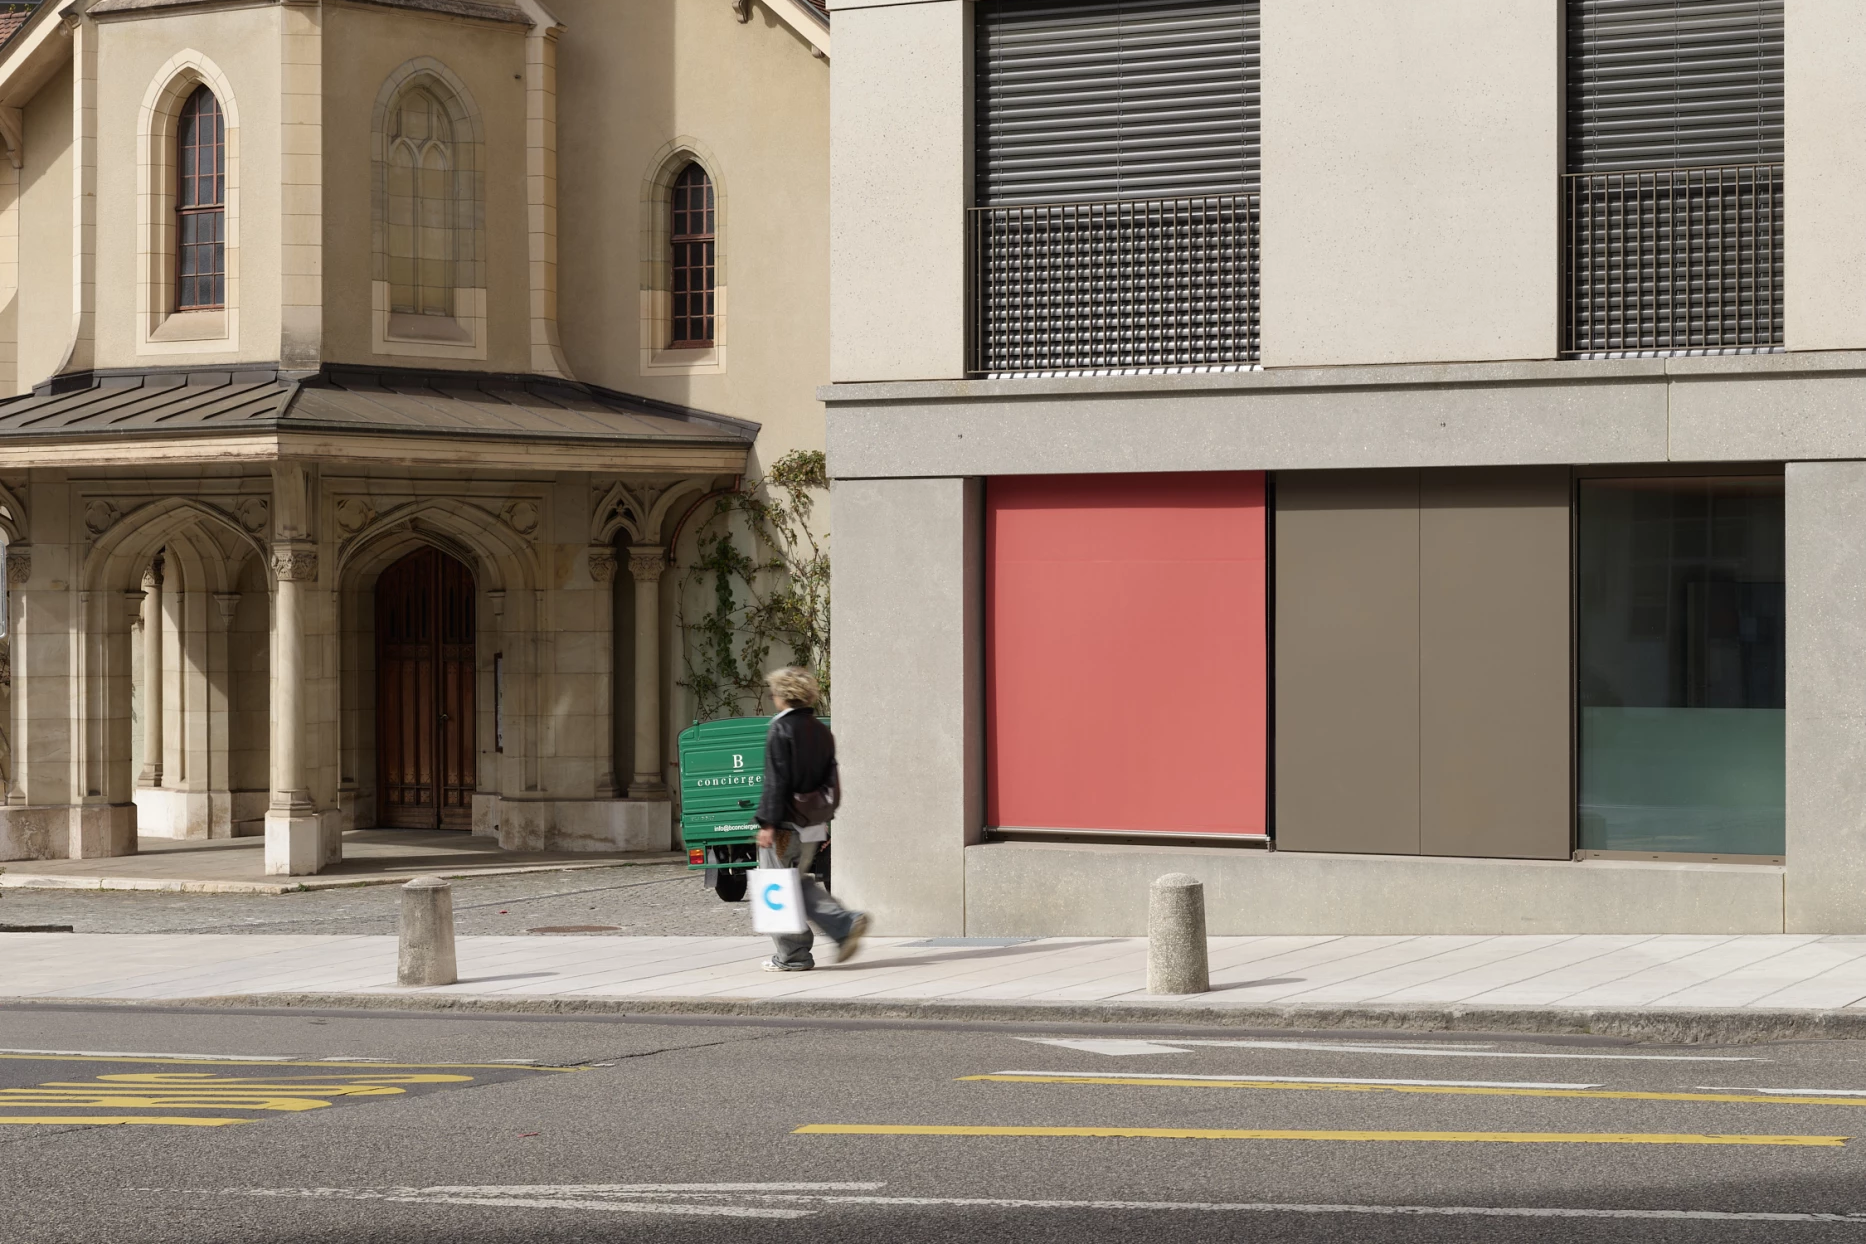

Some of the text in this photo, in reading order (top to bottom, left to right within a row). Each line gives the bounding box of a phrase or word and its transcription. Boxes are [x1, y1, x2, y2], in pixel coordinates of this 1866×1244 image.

[732, 754, 744, 769] B
[697, 774, 766, 787] concierge
[0, 1073, 474, 1111] BUS
